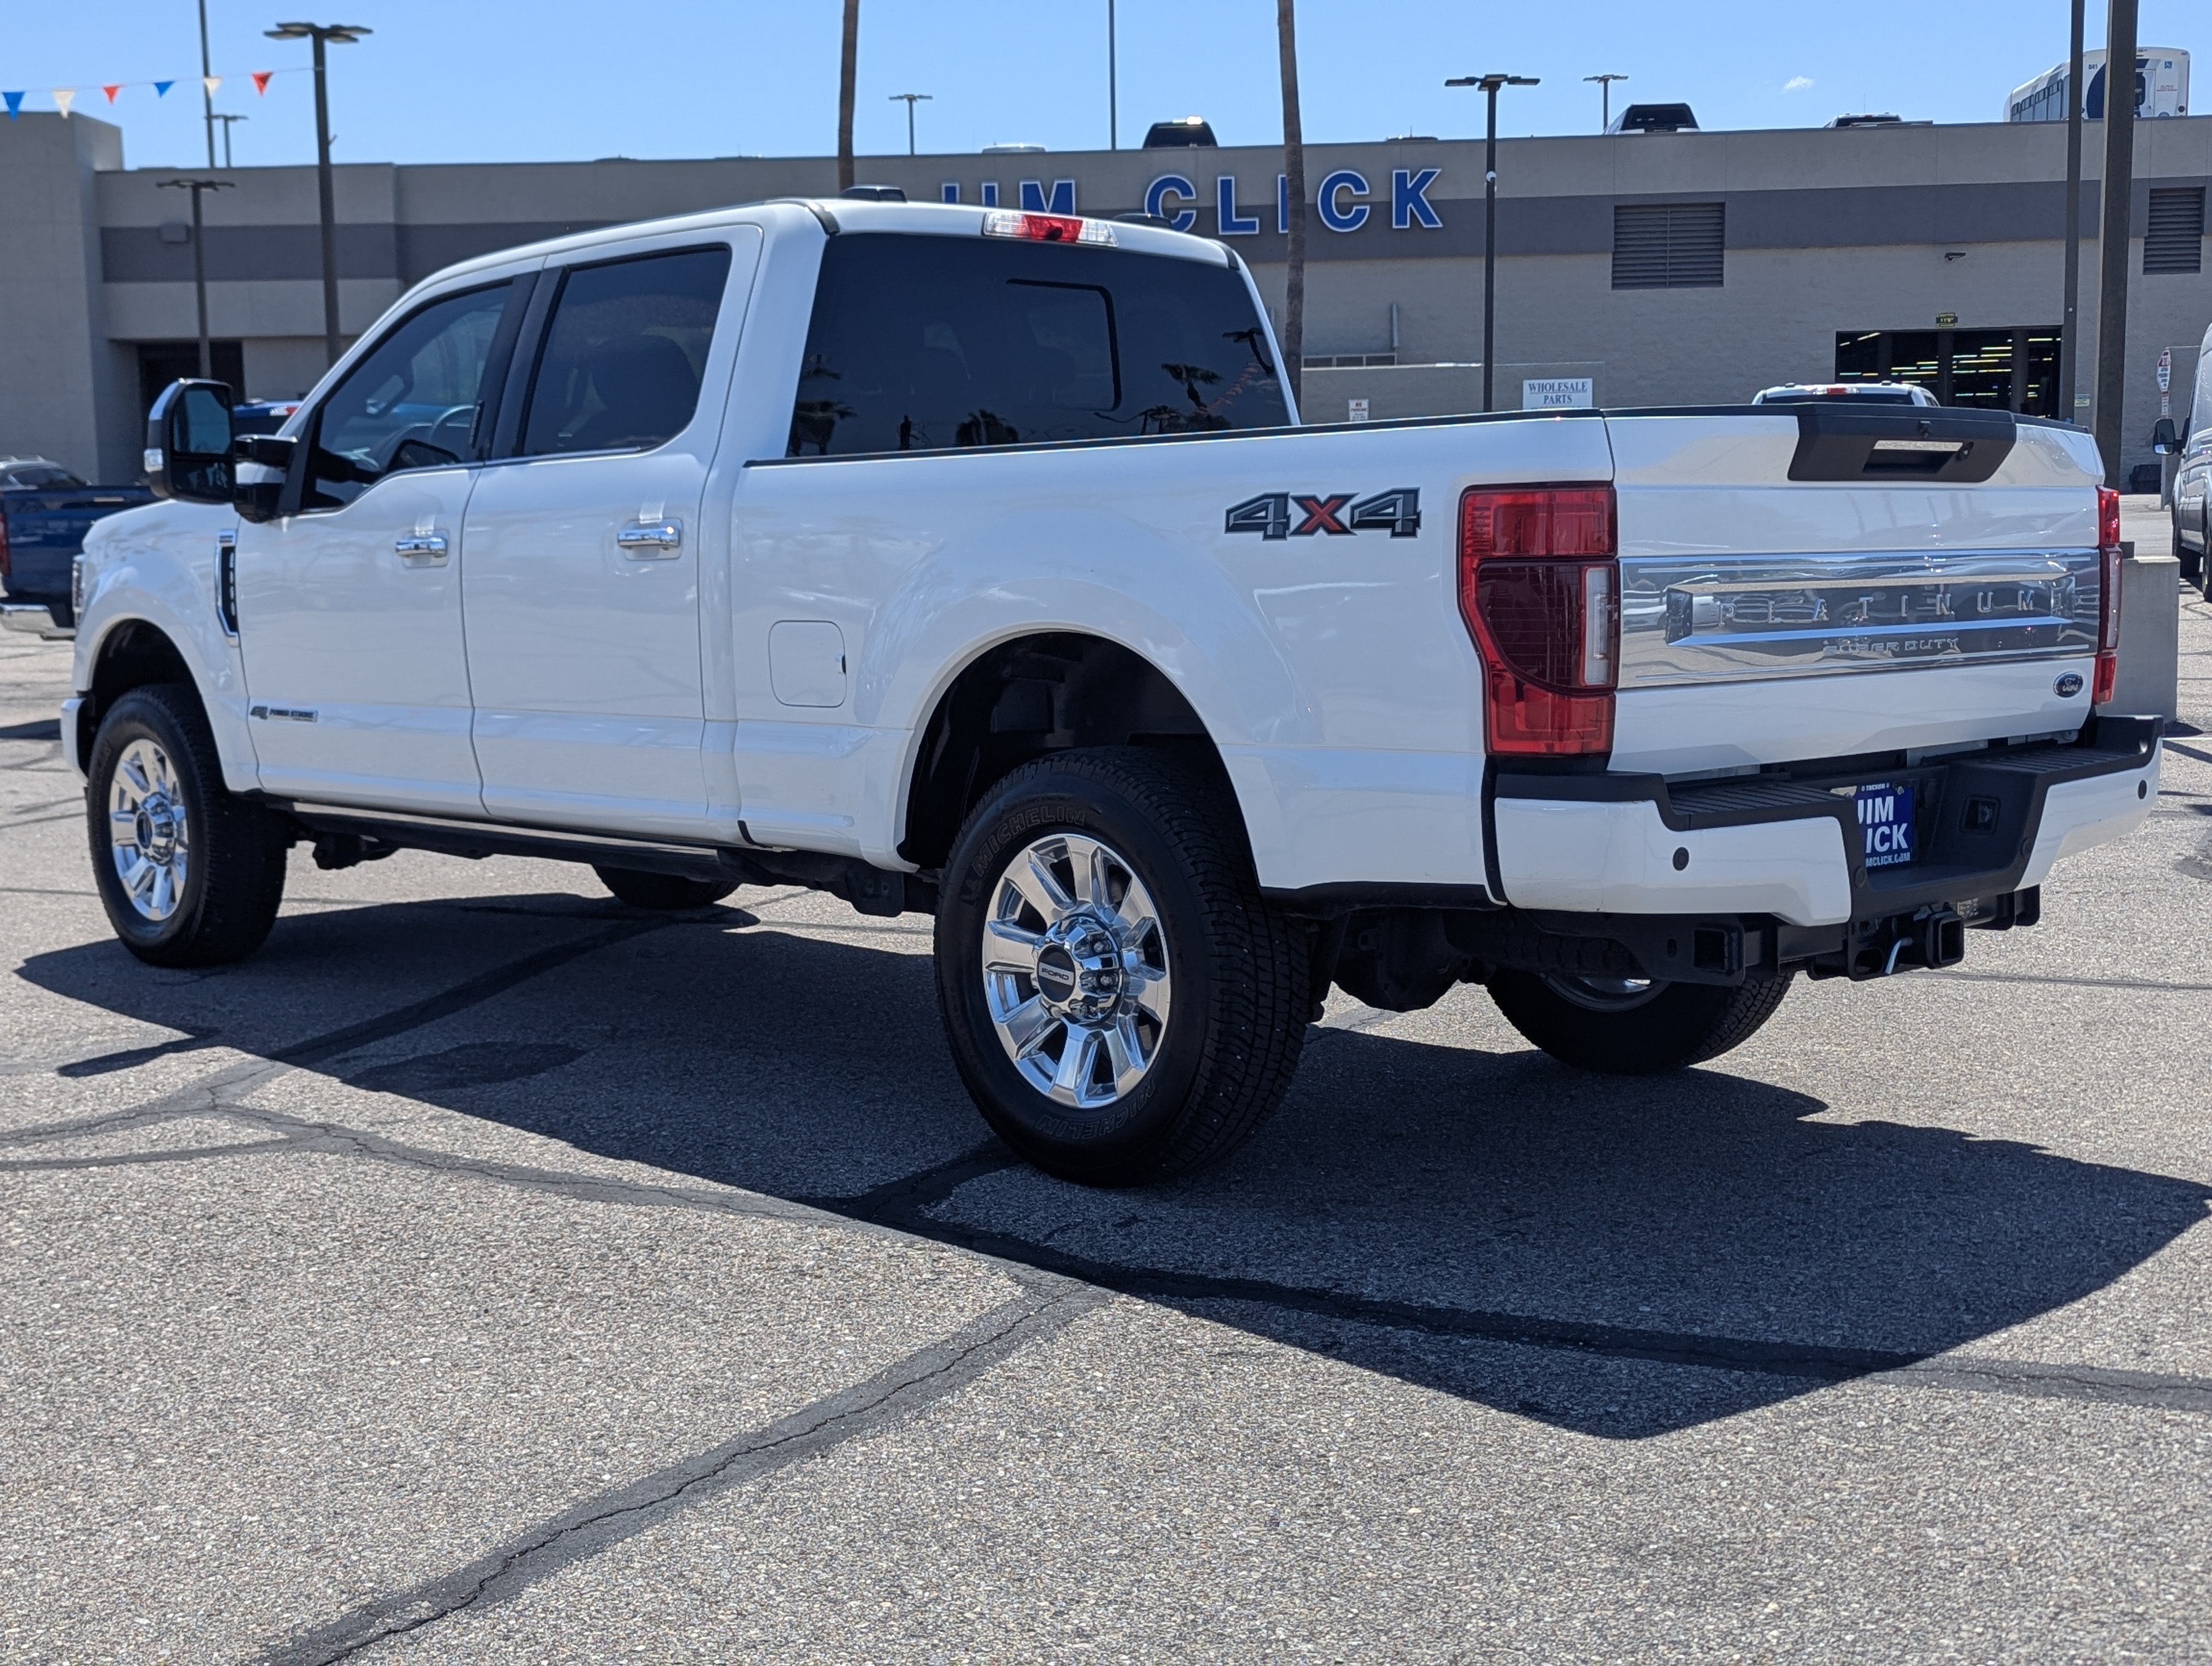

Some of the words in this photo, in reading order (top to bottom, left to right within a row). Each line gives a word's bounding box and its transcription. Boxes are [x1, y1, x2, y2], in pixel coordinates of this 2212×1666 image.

[1144, 169, 1443, 235] CLICK
[1528, 382, 1587, 392] WHOLESALE
[1544, 394, 1573, 404] PARTS
[1718, 590, 2035, 627] PLATINUM
[1904, 638, 1959, 651] DUTY
[972, 806, 1087, 877] MICHELIN
[1041, 967, 1069, 981] FORD
[1034, 1074, 1156, 1140] MICHELIN
